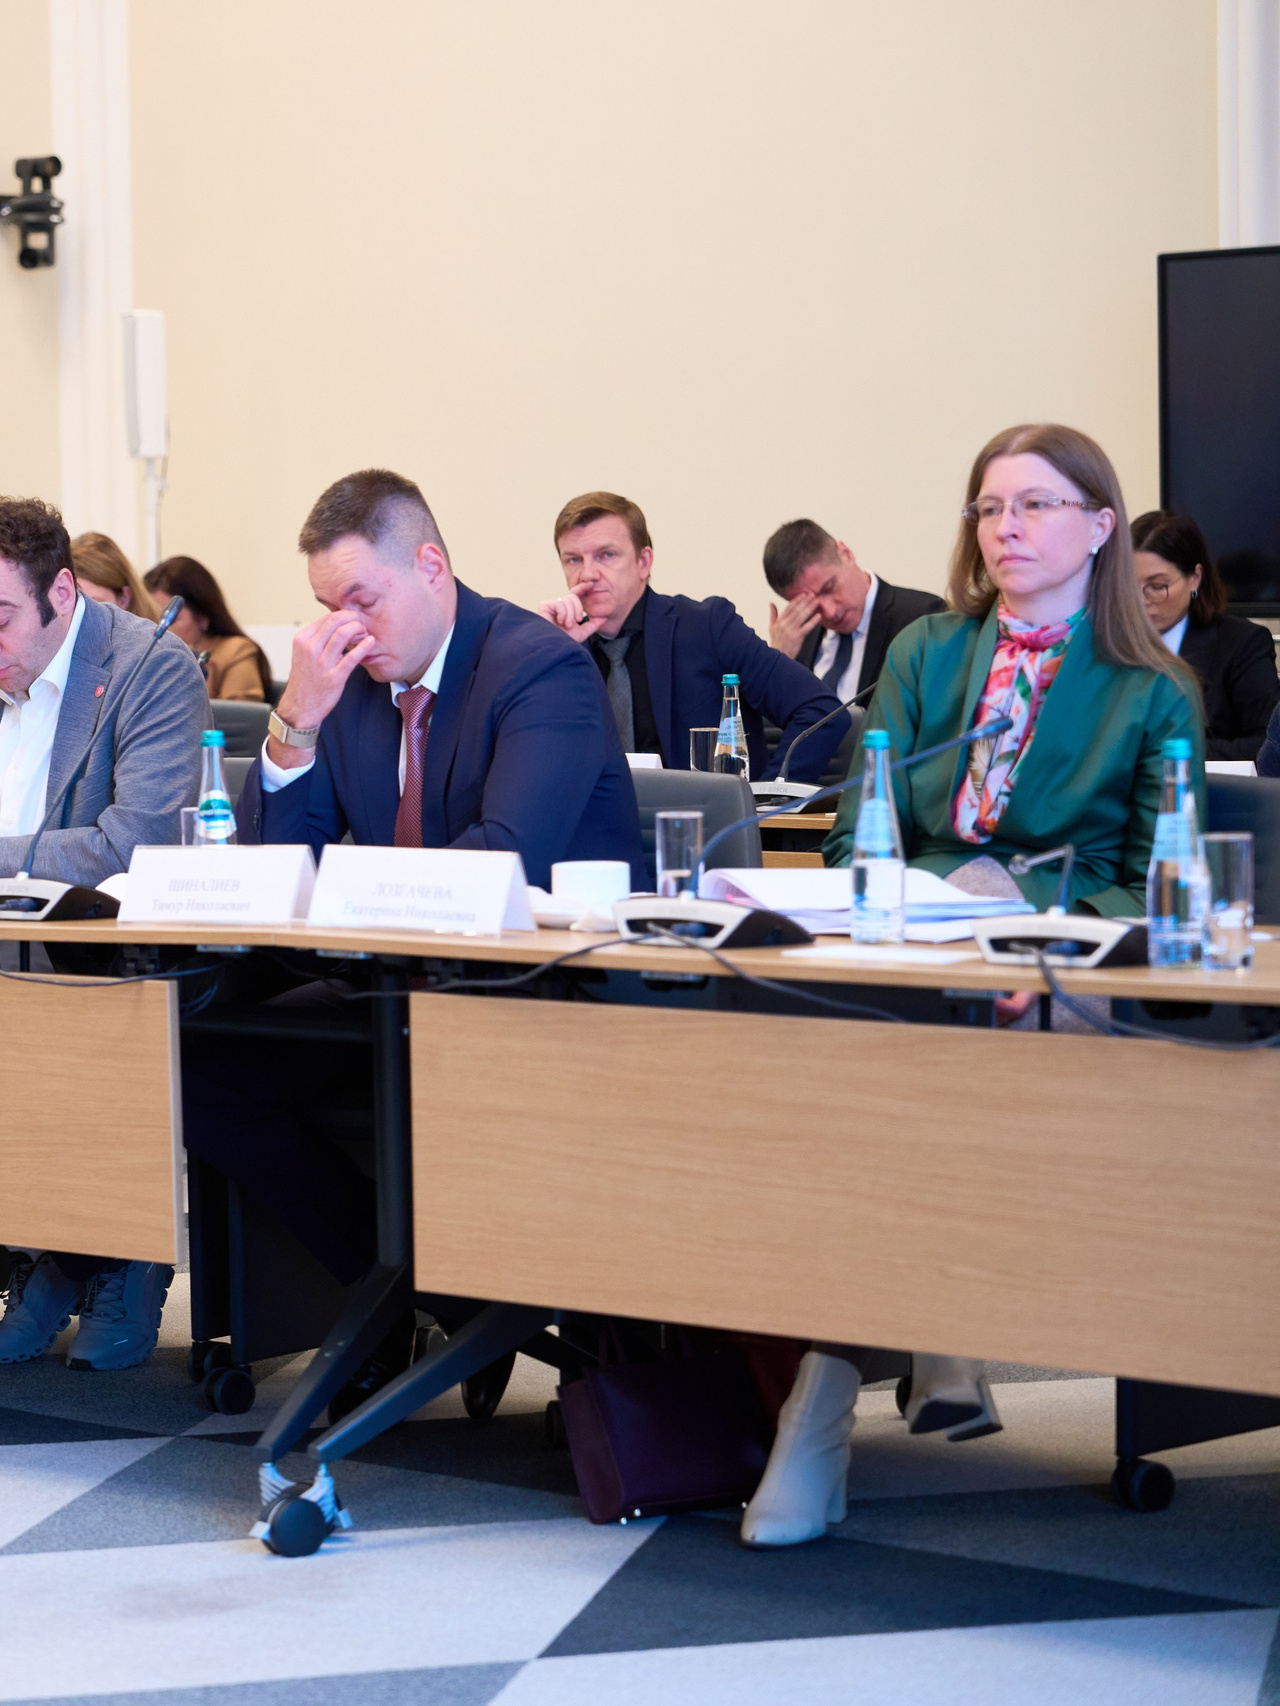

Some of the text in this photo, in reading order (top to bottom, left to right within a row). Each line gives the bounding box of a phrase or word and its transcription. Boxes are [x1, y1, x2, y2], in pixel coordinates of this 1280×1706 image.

[168, 879, 241, 892] ШИНАЛИЕВ
[371, 882, 453, 900] ЛОЗГАЧЕВА
[152, 899, 251, 914] Тимур Николаевич
[343, 901, 476, 922] Екатерина Николаевна
